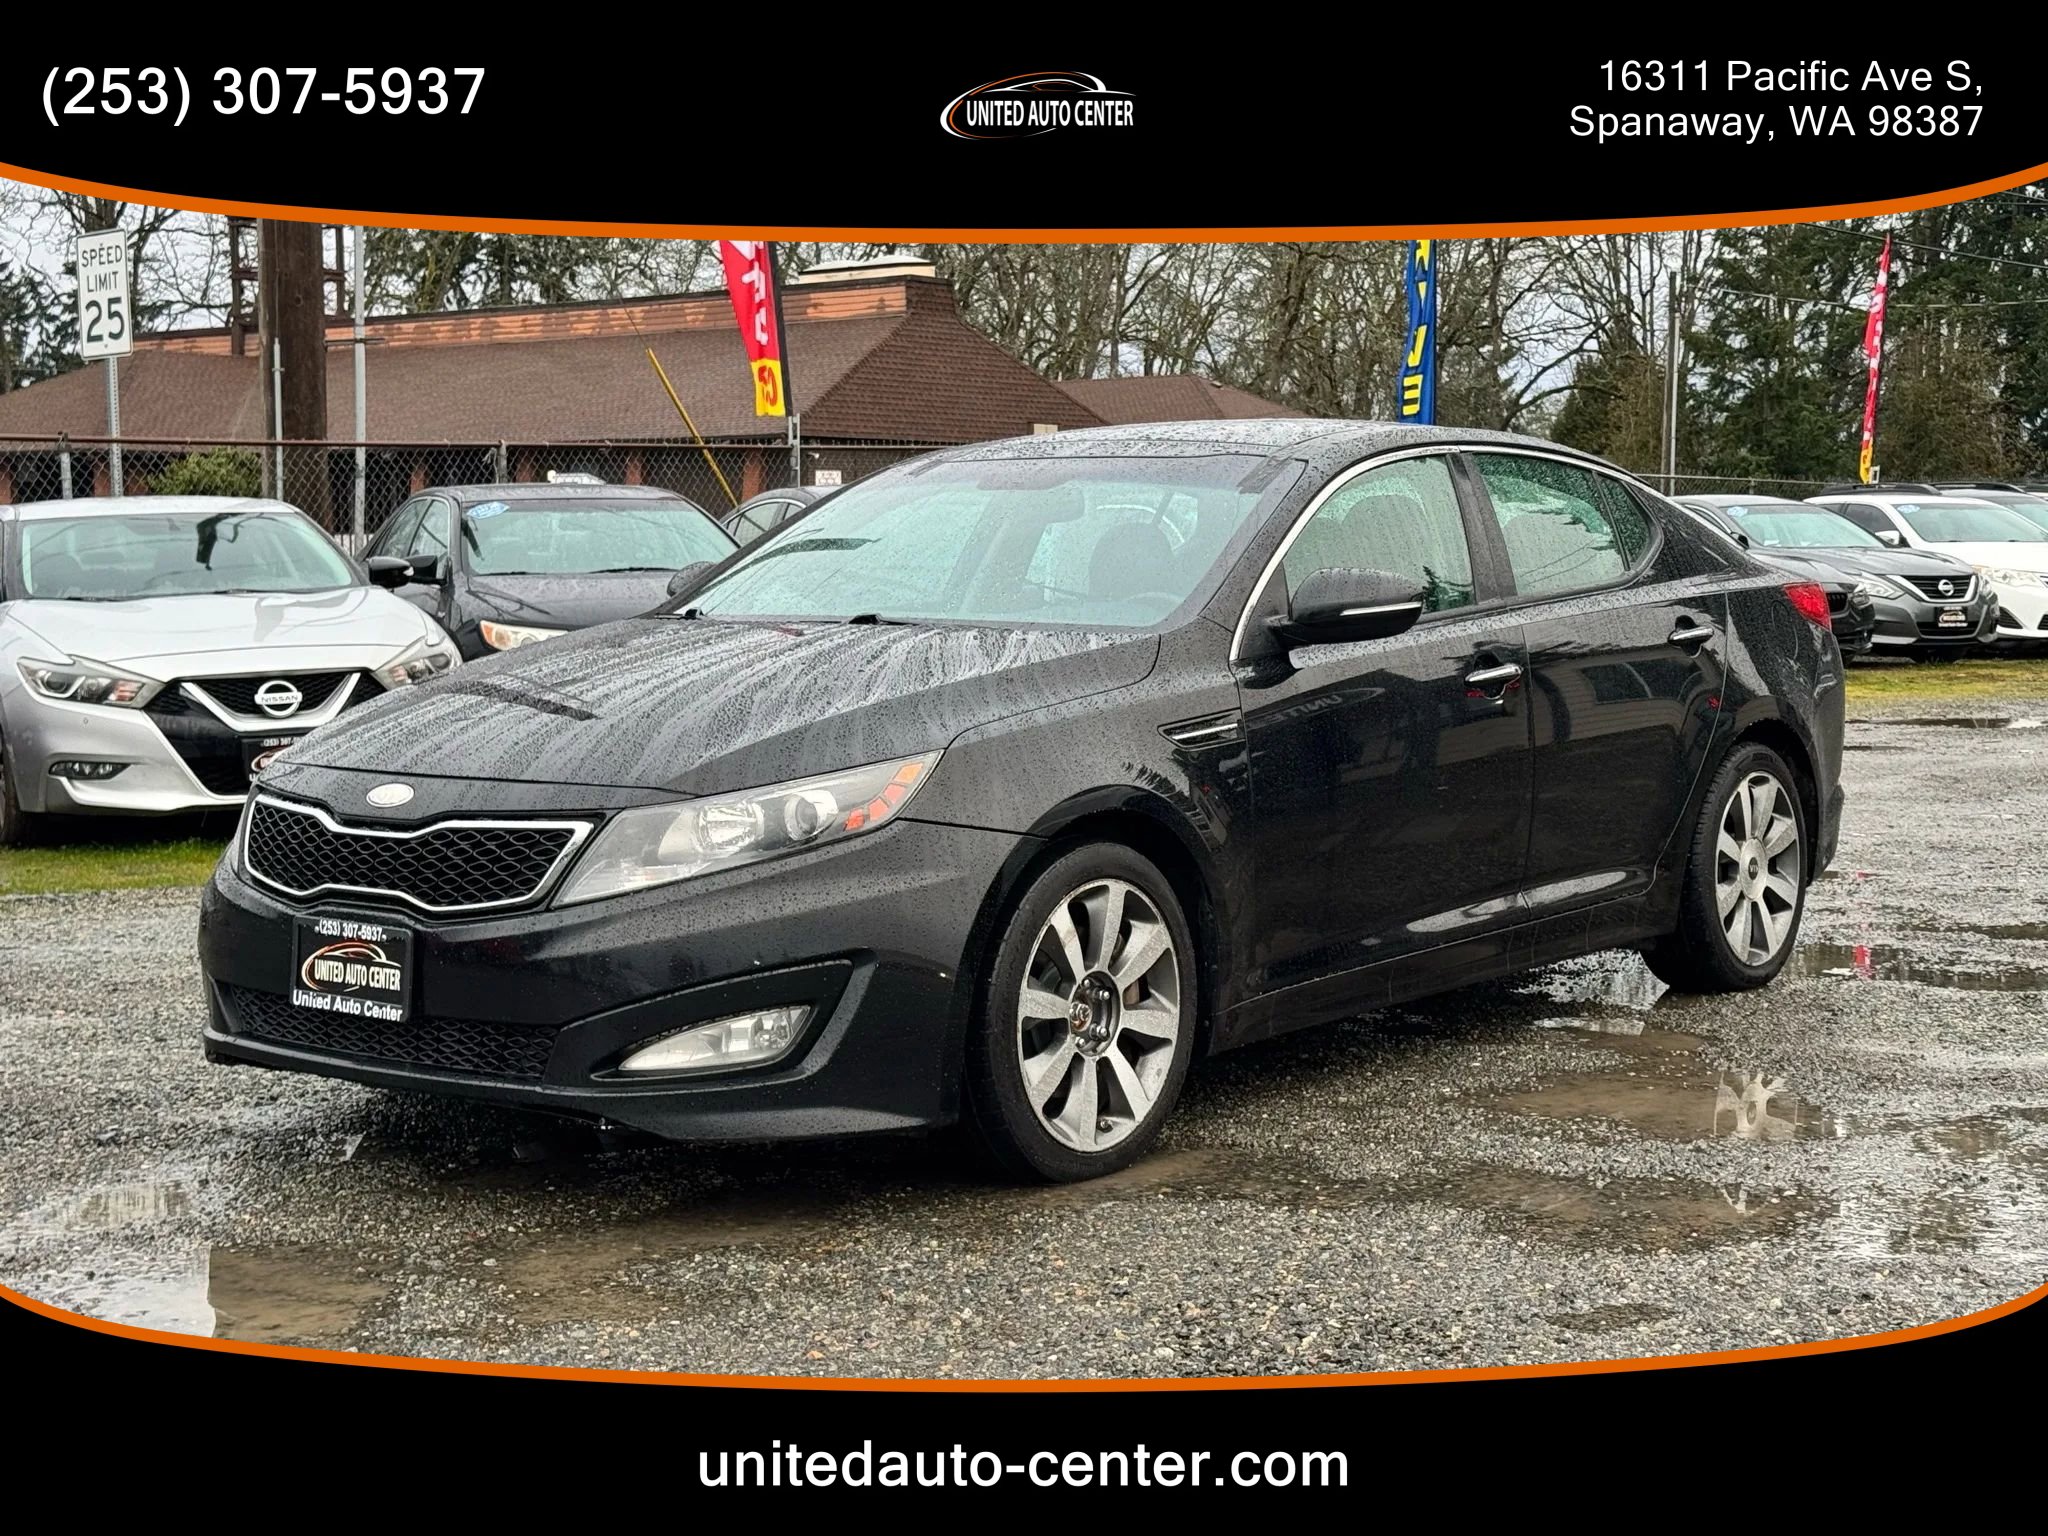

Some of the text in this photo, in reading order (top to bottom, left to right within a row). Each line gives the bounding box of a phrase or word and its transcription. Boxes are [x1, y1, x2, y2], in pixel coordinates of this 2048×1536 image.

[82, 245, 122, 267] SPEED
[87, 271, 118, 292] LIMIT
[85, 296, 124, 342] 25
[261, 695, 299, 703] NISSAN
[319, 919, 383, 941] (253) 307-5937
[314, 959, 401, 991] UNITED AUTO CENTER
[293, 989, 403, 1022] United Auto Center
